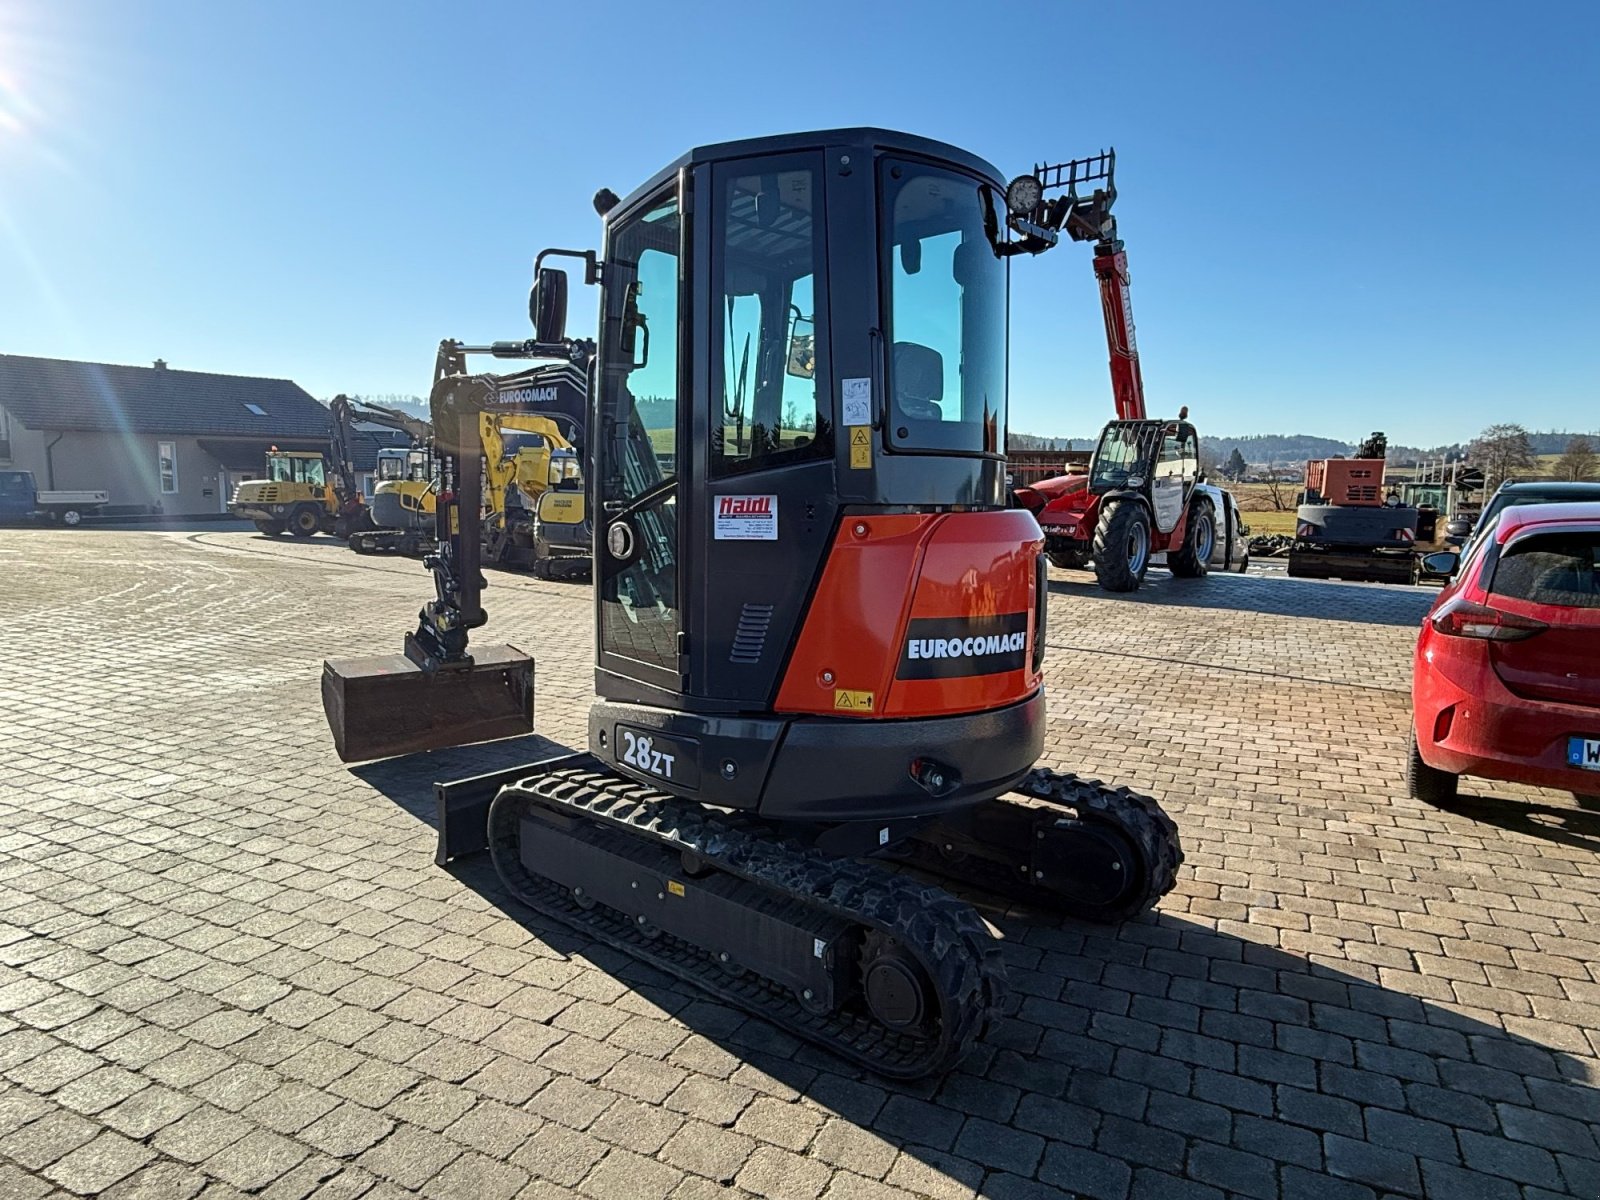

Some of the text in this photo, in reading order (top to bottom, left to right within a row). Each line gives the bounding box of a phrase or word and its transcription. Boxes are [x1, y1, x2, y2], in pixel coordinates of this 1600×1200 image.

[499, 387, 557, 403] EUROCOMACH
[908, 632, 1025, 659] EUROCOMACH
[623, 731, 675, 778] 28ZT
